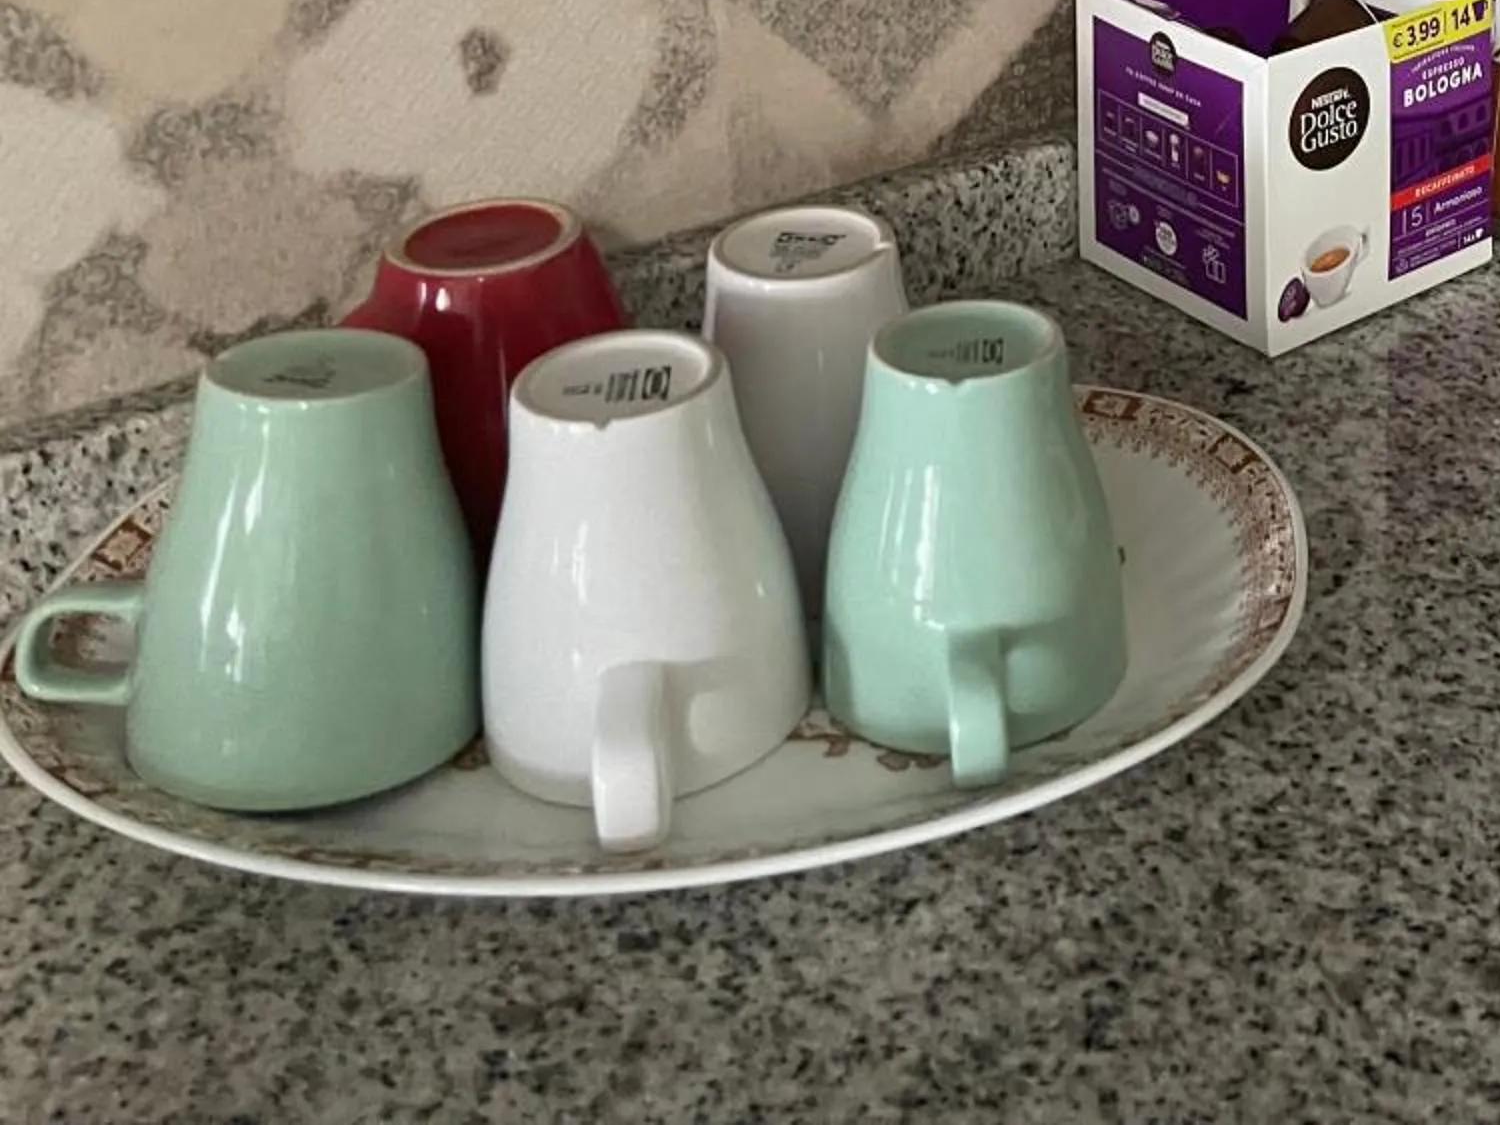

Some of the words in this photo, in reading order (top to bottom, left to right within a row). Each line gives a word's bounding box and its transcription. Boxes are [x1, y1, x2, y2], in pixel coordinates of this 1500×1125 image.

[1451, 3, 1471, 30] 14
[1403, 61, 1483, 108] BOLOGNA
[1421, 56, 1465, 80] ESPRESSO
[1300, 100, 1357, 136] Dolce
[1300, 120, 1357, 153] Gusto
